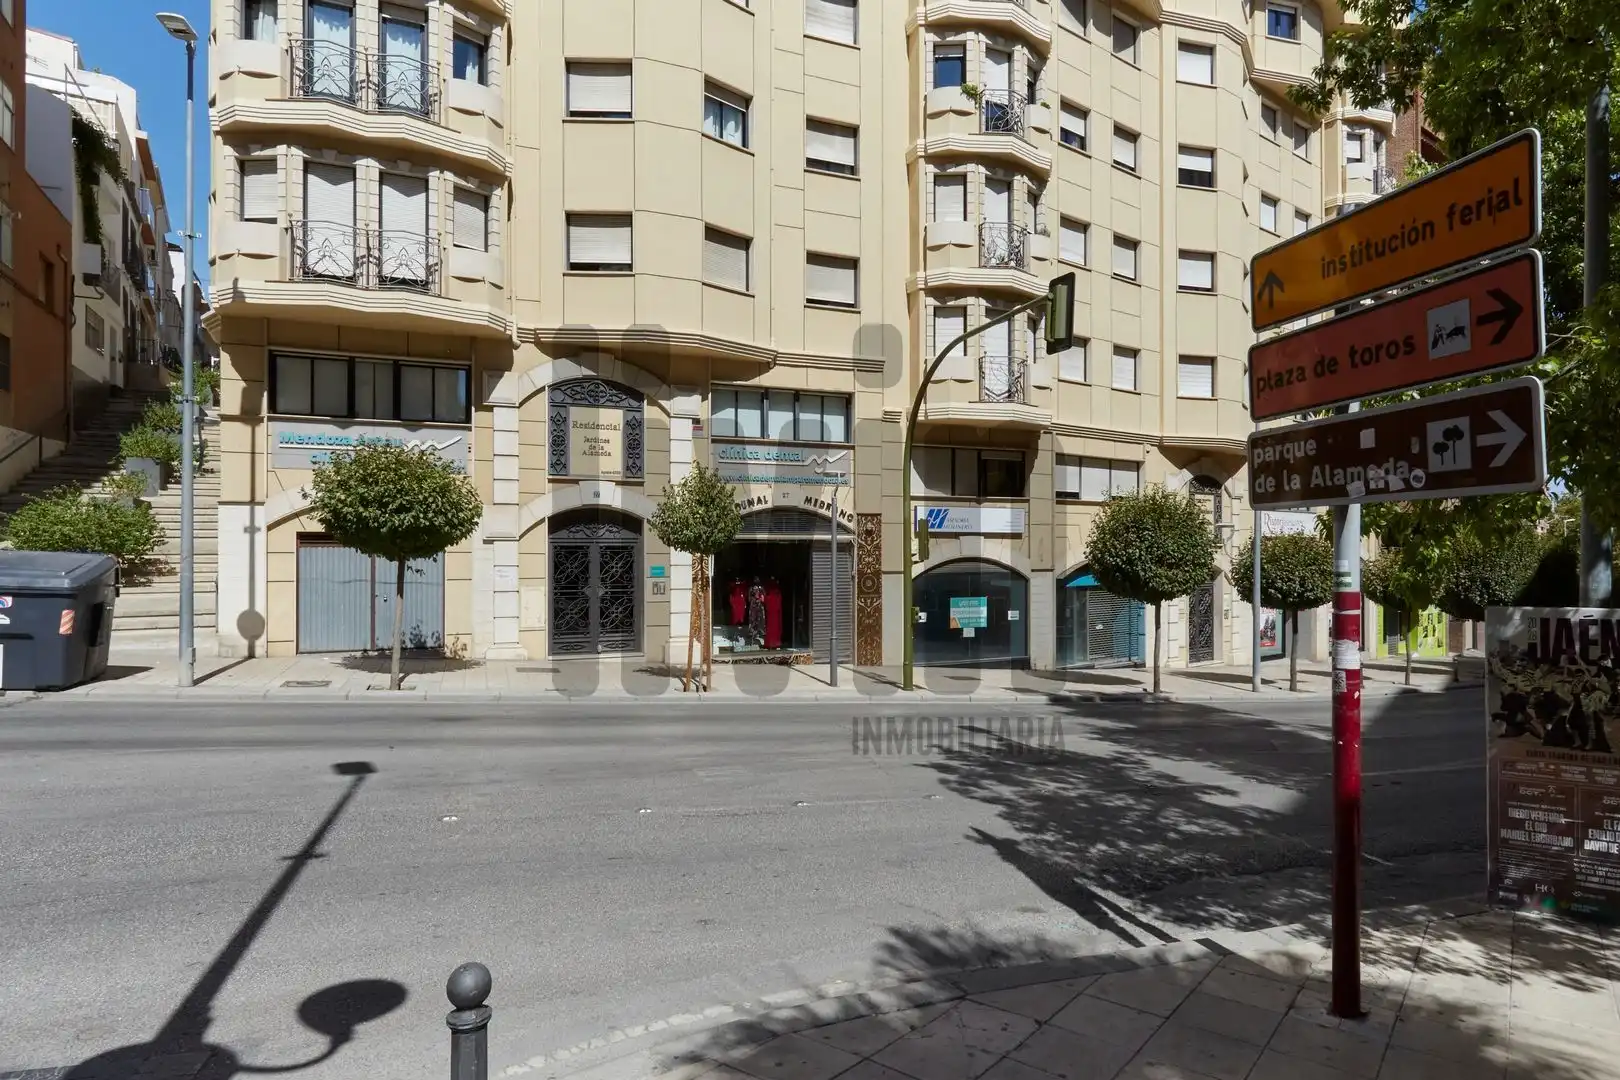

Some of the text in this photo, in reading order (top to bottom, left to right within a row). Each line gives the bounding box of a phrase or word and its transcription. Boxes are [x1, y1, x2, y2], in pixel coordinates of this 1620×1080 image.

[1321, 177, 1524, 280] institución ferial
[1255, 333, 1416, 399] plaza de toros
[571, 421, 621, 431] Residencial
[279, 431, 353, 447] Mendoza
[583, 436, 610, 444] Jardines
[718, 446, 805, 462] clínica dental
[1253, 436, 1317, 468] parque
[1254, 469, 1277, 494] de
[1283, 467, 1302, 491] la
[803, 495, 854, 523] MEDRNO
[1584, 839, 1607, 852] DAVID
